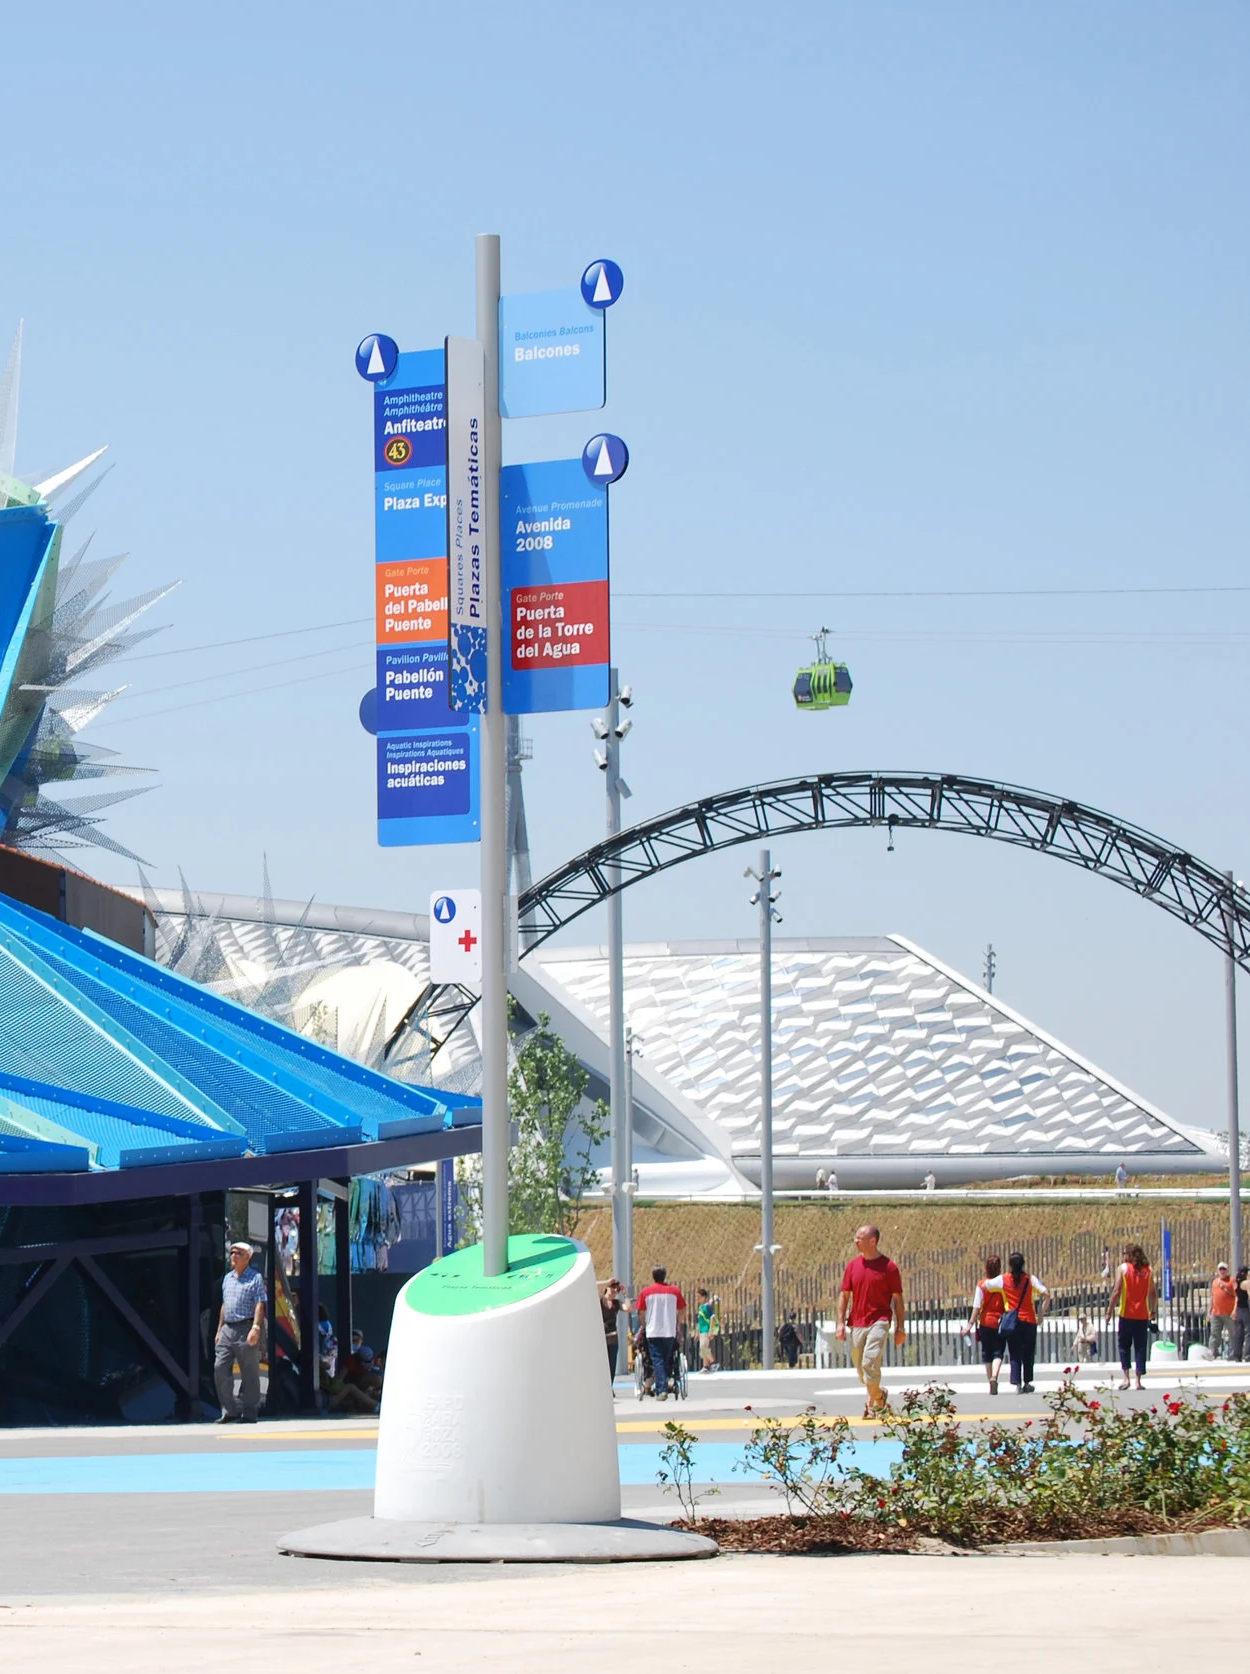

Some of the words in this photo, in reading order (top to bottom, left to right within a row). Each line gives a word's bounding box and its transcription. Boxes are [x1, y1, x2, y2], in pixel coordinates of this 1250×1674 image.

[514, 328, 557, 341] Balconies
[559, 324, 594, 336] Balcons
[514, 343, 581, 362] Balcones
[383, 391, 443, 406] Amphitheatre
[383, 402, 443, 417] Amphithéâtre
[388, 442, 406, 459] 43
[467, 417, 480, 536] Temáticas
[384, 481, 415, 493] Square
[417, 478, 442, 489] Place
[383, 496, 420, 511] Plaza
[423, 492, 447, 509] Exp
[515, 504, 549, 515] Avenue
[551, 498, 603, 511] Promenade
[455, 498, 463, 549] Places
[515, 516, 571, 535] Avenida
[516, 535, 554, 552] 2008
[385, 567, 405, 578] Gate
[407, 565, 430, 577] Porte
[384, 582, 429, 598] Puerta
[455, 554, 464, 616] Squares
[469, 544, 480, 619] Plazas
[384, 599, 404, 615] del
[408, 596, 448, 613] Pabell
[516, 592, 538, 604] Gate
[539, 590, 564, 602] Porte
[516, 604, 565, 622] Puerta
[384, 616, 432, 633] Puente
[516, 624, 534, 641] de
[538, 622, 552, 639] la
[555, 621, 594, 637] Torre
[516, 642, 539, 659] del
[542, 641, 581, 659] Agua
[386, 654, 420, 666] Pavilion
[385, 667, 444, 686] Pabellón
[385, 685, 433, 702] Puente
[386, 742, 412, 752] Aquatic
[413, 739, 453, 750] Inspirations
[386, 749, 426, 760] Inspirations
[426, 747, 464, 758] Aquatiques
[387, 758, 467, 775] Inspiraciones
[387, 773, 445, 789] acuáticas
